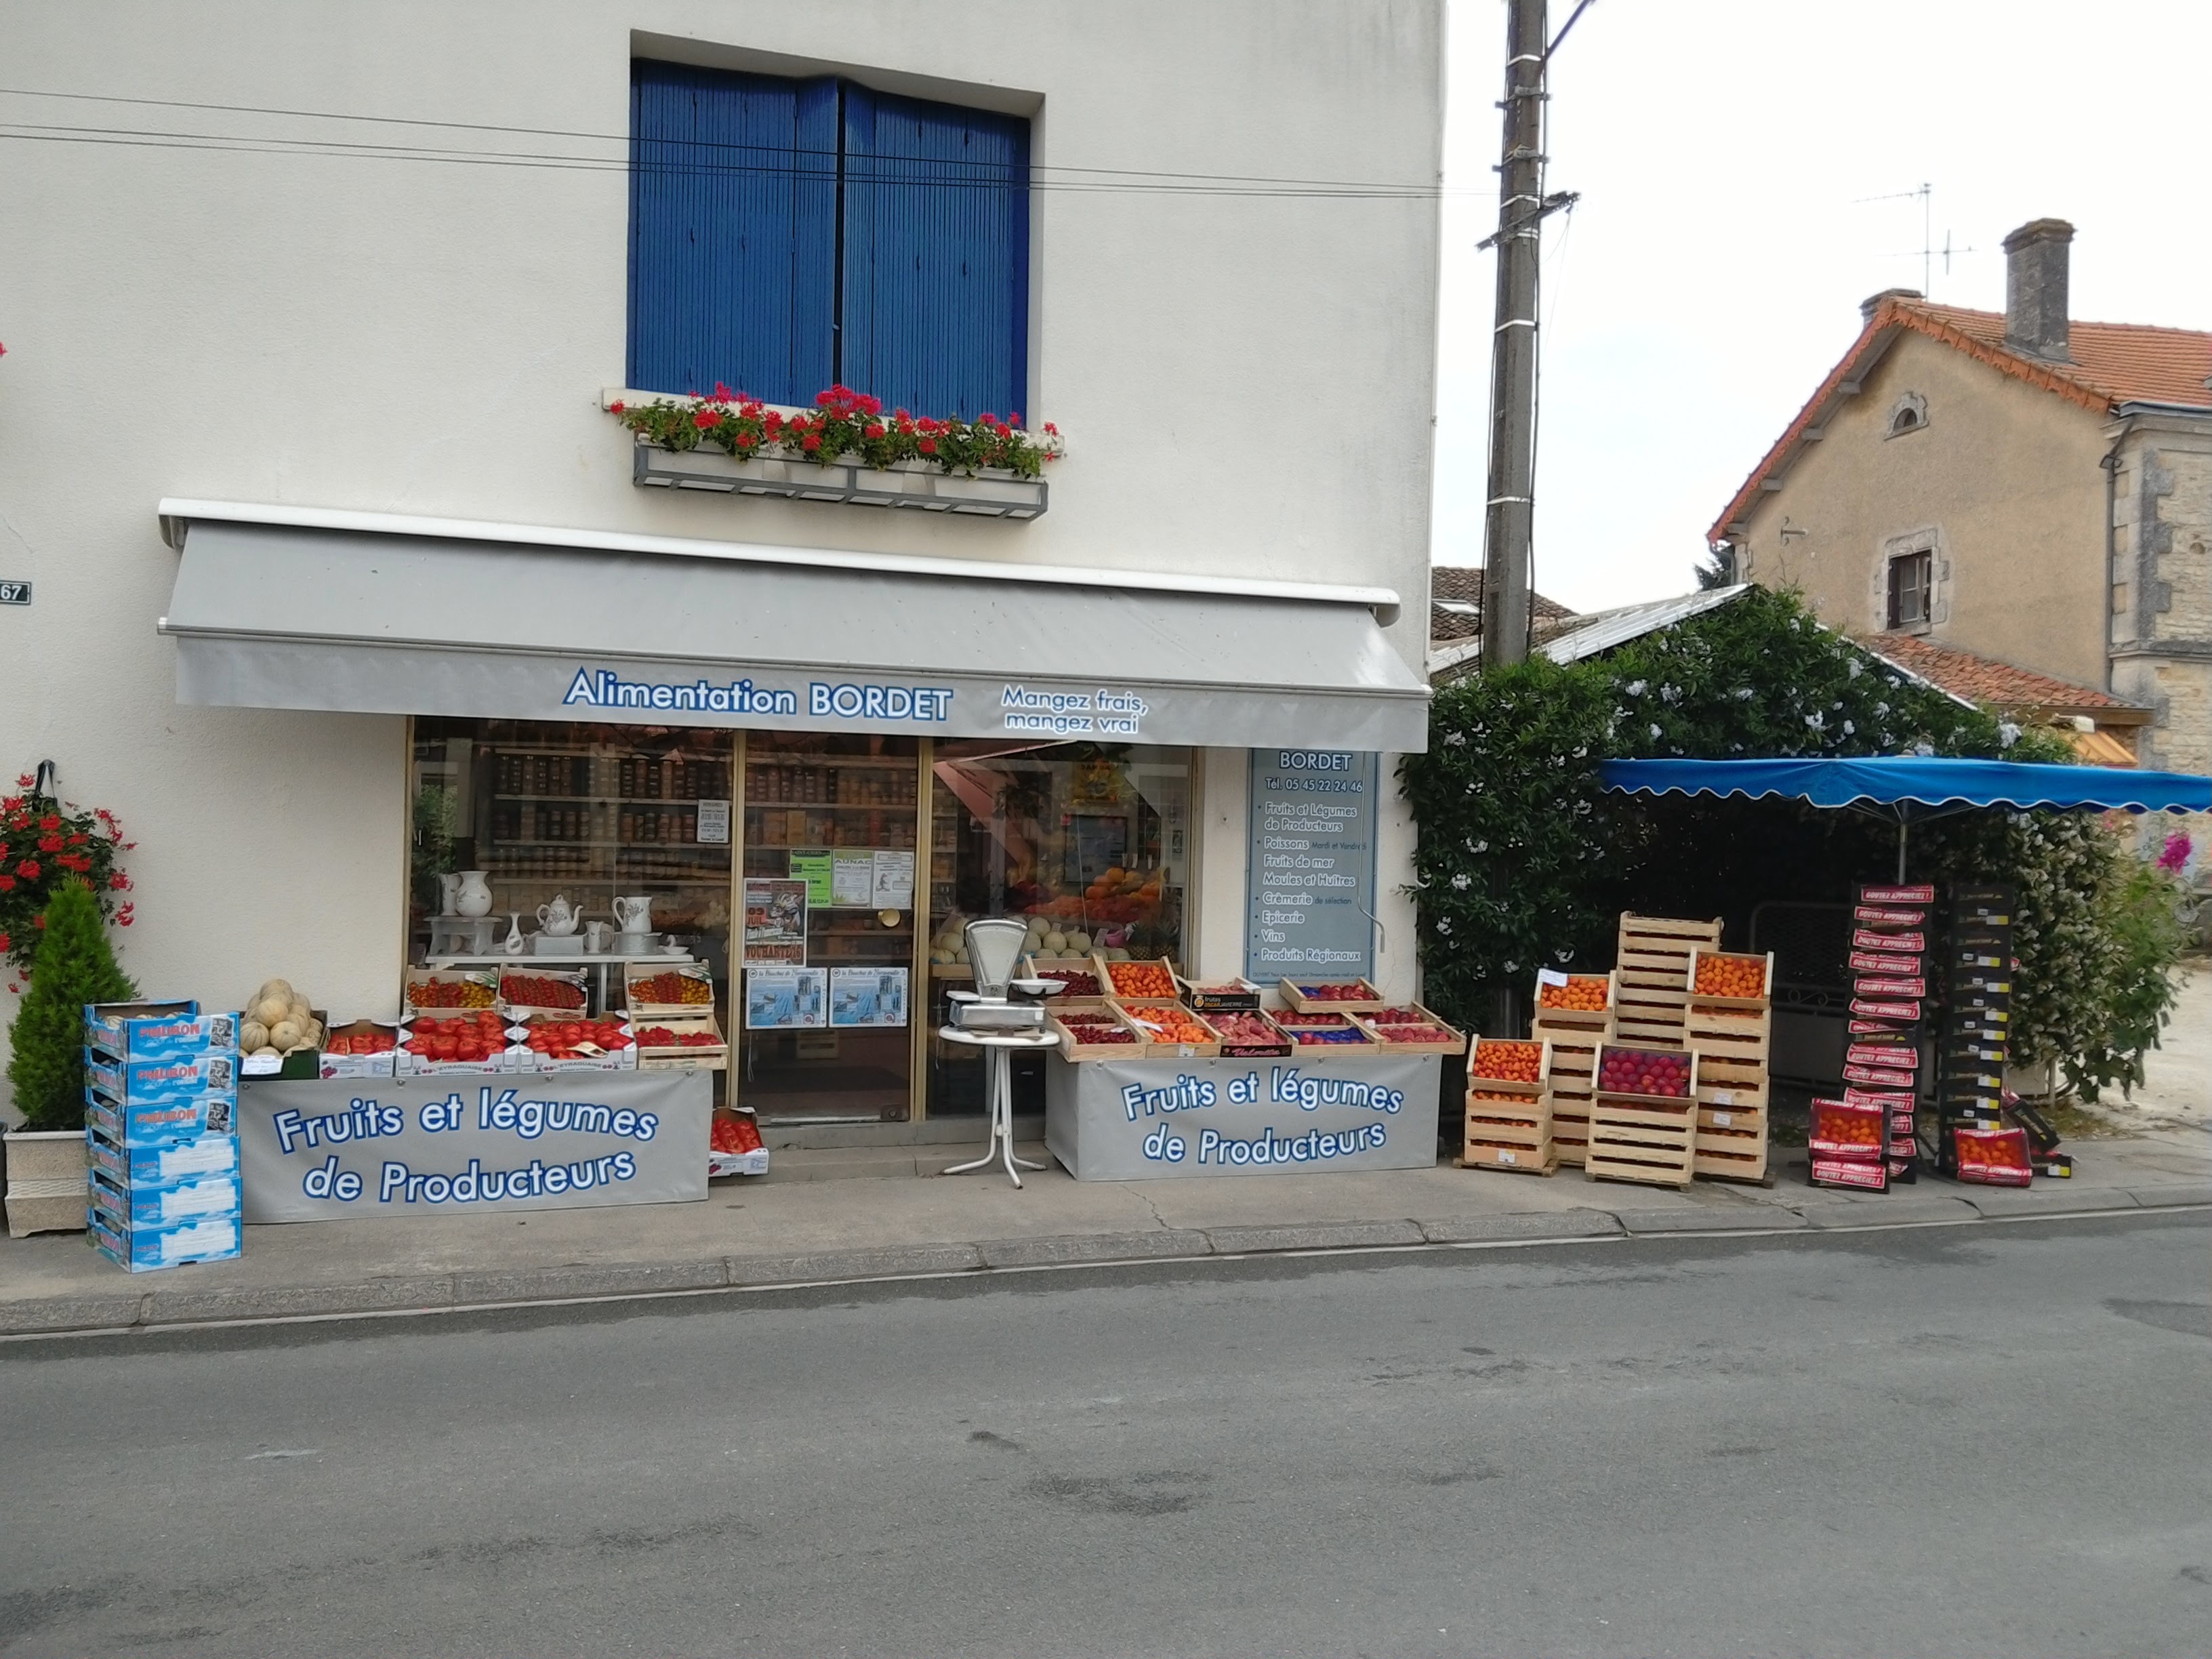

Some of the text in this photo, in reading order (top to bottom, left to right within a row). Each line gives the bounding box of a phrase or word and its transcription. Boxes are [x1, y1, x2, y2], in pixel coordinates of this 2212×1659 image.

[1, 584, 22, 600] 67
[562, 666, 953, 721] Alimentation BORDET
[1002, 684, 1148, 716] Mangez frais,
[1005, 713, 1139, 735] mangez vrai
[1279, 751, 1353, 771] BORDET
[1265, 777, 1363, 793] Tél. 05 45 22 24 46
[1265, 801, 1357, 819] Fruits et Légumes
[1264, 817, 1343, 832] de Producteurs
[1264, 836, 1309, 850] Poissons
[1264, 854, 1334, 869] Fruits de mer
[1263, 872, 1355, 887] Moules et Huîtres
[1263, 891, 1352, 905] Crèmerie de sélection
[1262, 910, 1305, 926] Epicerie
[1261, 929, 1285, 943] Vins
[1261, 947, 1361, 964] Produits Régionaux
[1121, 1066, 1404, 1122] Fruits et légumes
[272, 1086, 659, 1153] Fruits et légumes
[1142, 1122, 1387, 1165] de Producteurs
[302, 1151, 636, 1203] de Producteurs
